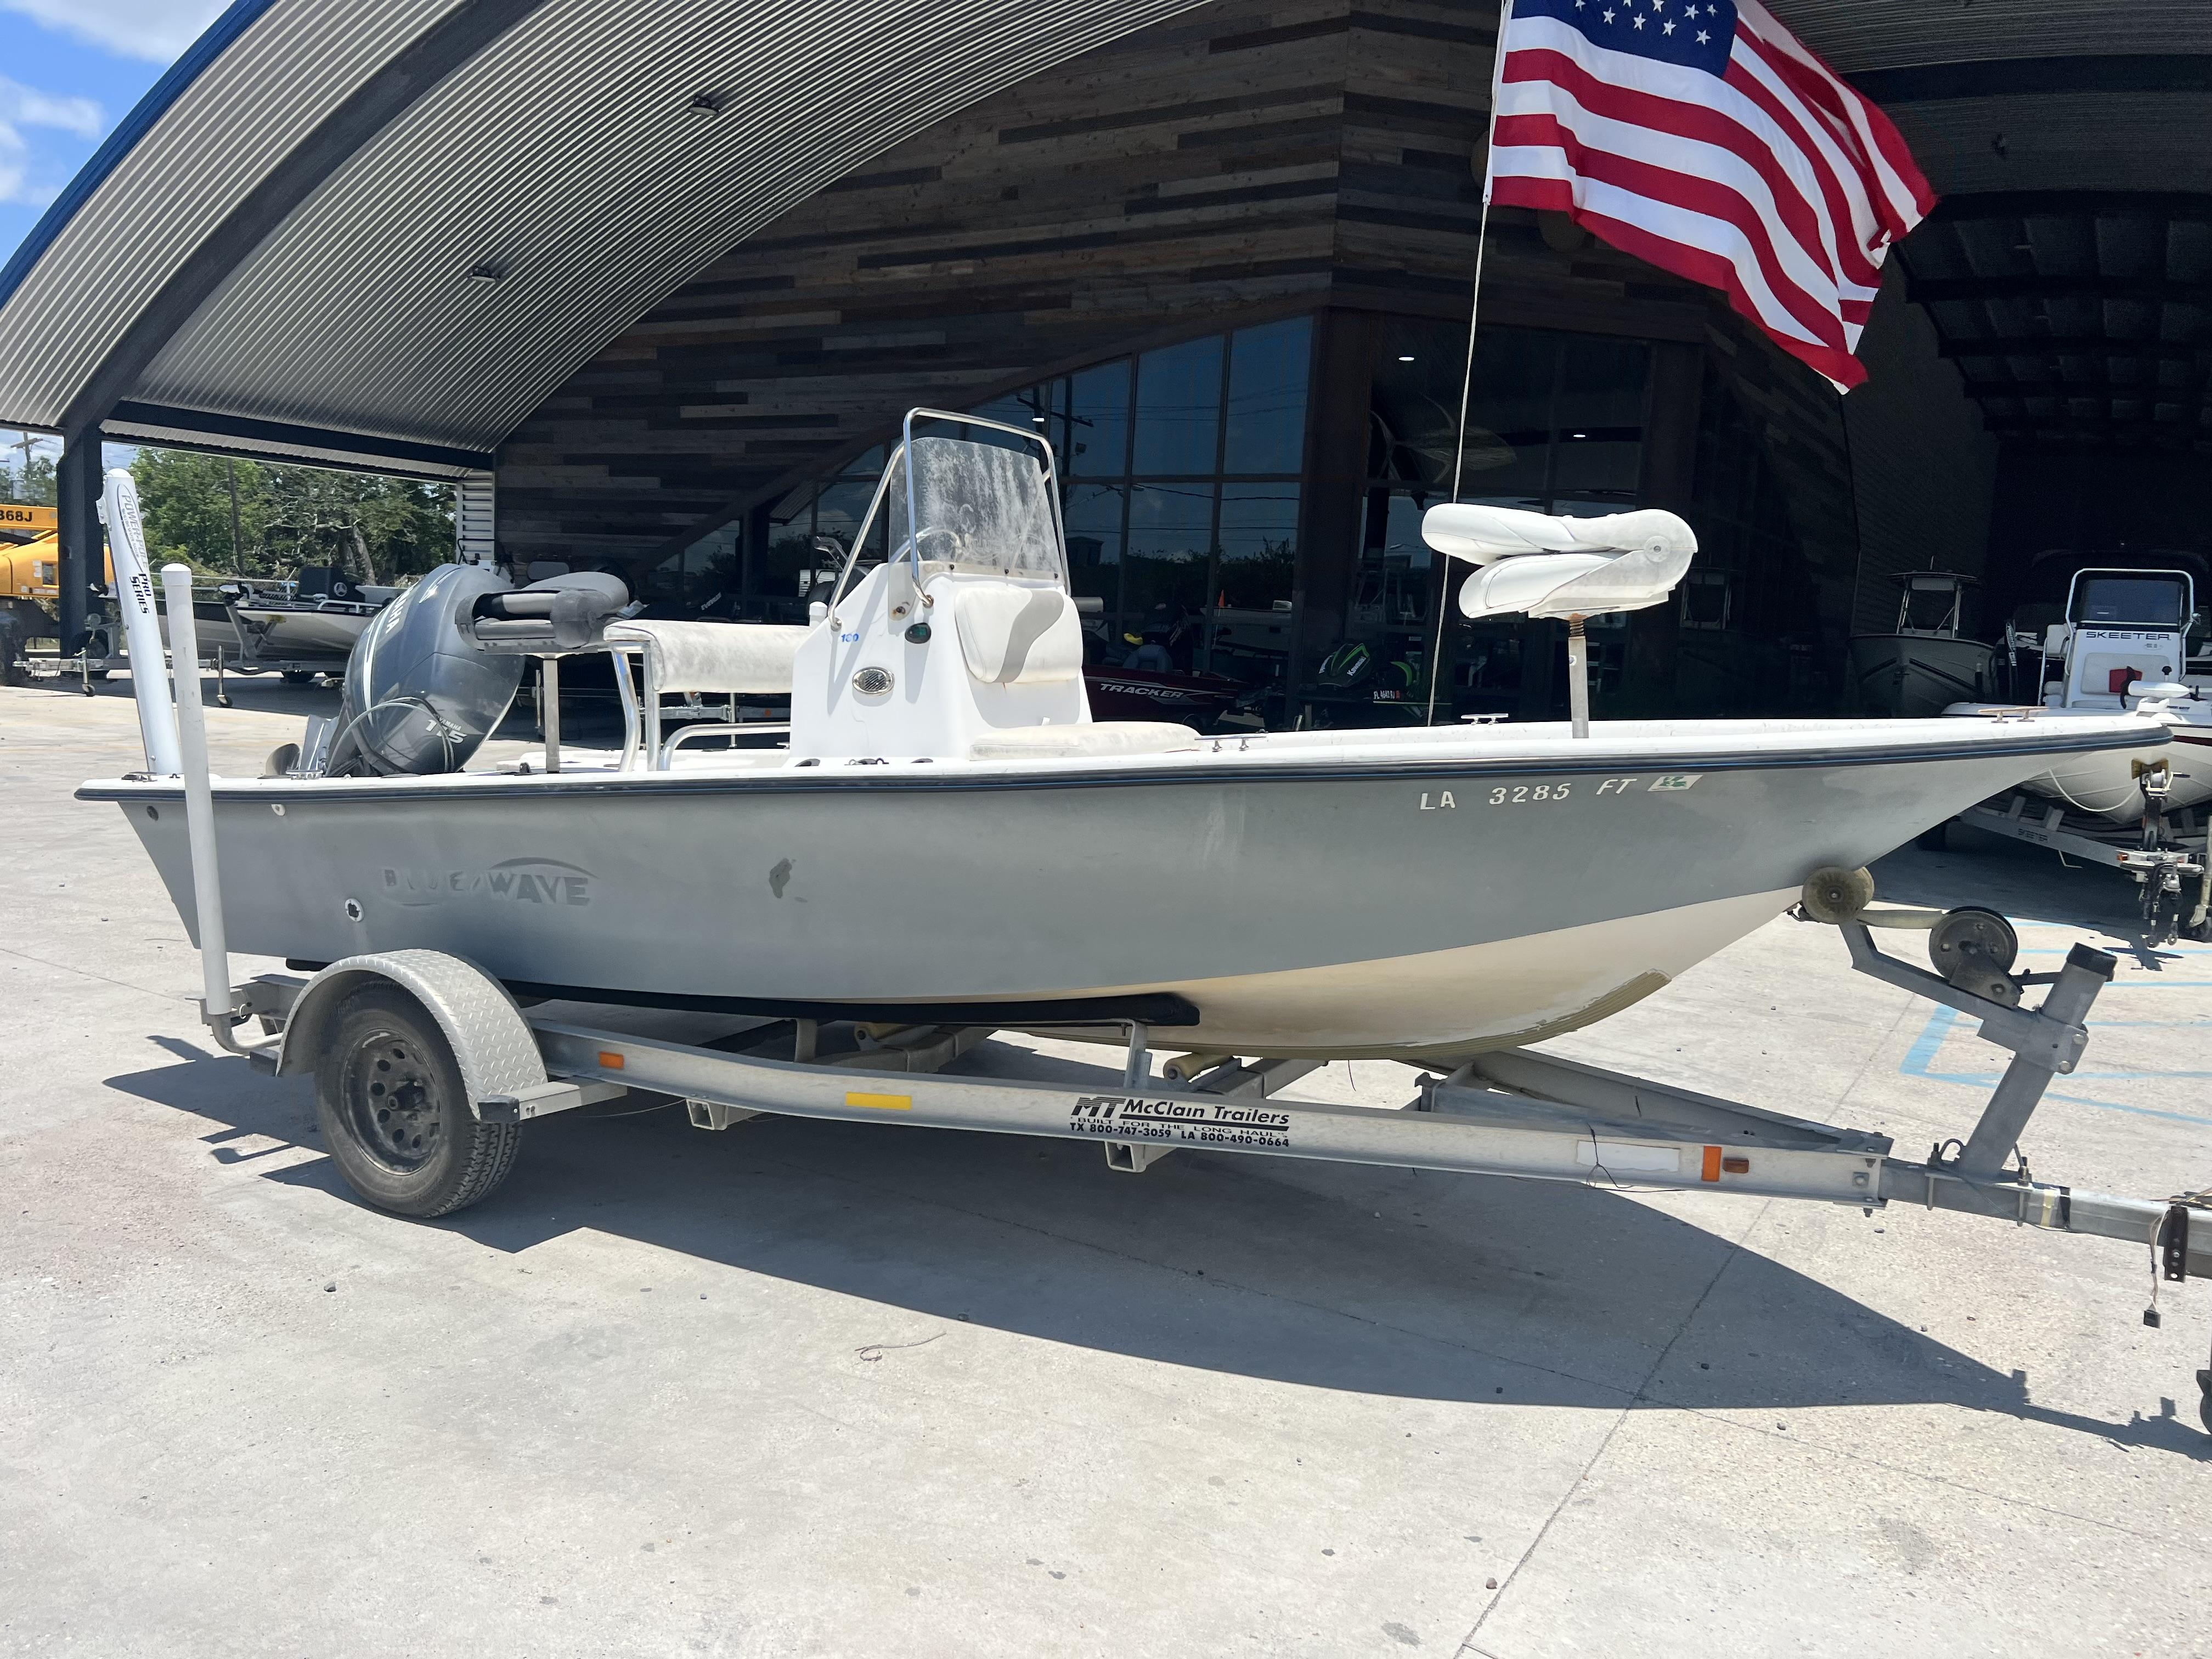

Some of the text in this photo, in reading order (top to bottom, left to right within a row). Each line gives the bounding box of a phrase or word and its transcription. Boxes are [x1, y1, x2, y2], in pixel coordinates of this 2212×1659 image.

[129, 577, 150, 613] SERIES
[138, 573, 151, 596] PRO
[2086, 631, 2170, 641] SKEETER
[1101, 684, 1184, 698] TRACKER
[439, 717, 462, 731] YAMAHA
[1420, 791, 1455, 810] LA
[1489, 783, 1571, 805] 3285
[1596, 778, 1638, 795] FT
[1071, 1097, 1126, 1118] MT
[1124, 1099, 1289, 1125] McClain Trailers
[1070, 1122, 1289, 1147] TX 800-747-3059 LA 800-490-0664
[1194, 1126, 1232, 1134] LONG
